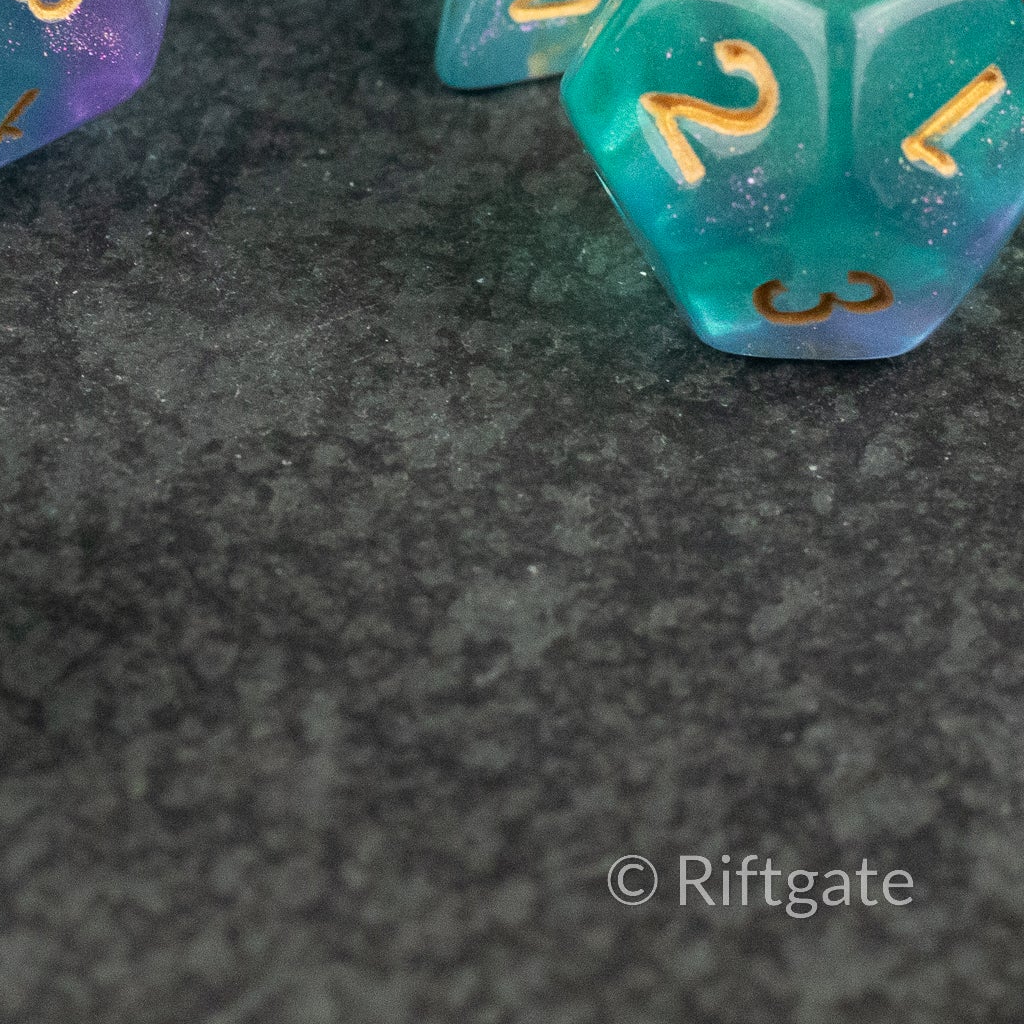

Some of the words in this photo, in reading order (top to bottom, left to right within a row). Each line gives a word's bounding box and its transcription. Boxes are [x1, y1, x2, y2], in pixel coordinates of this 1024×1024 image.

[639, 39, 780, 184] 2
[901, 65, 1007, 178] 1
[752, 271, 894, 325] 3
